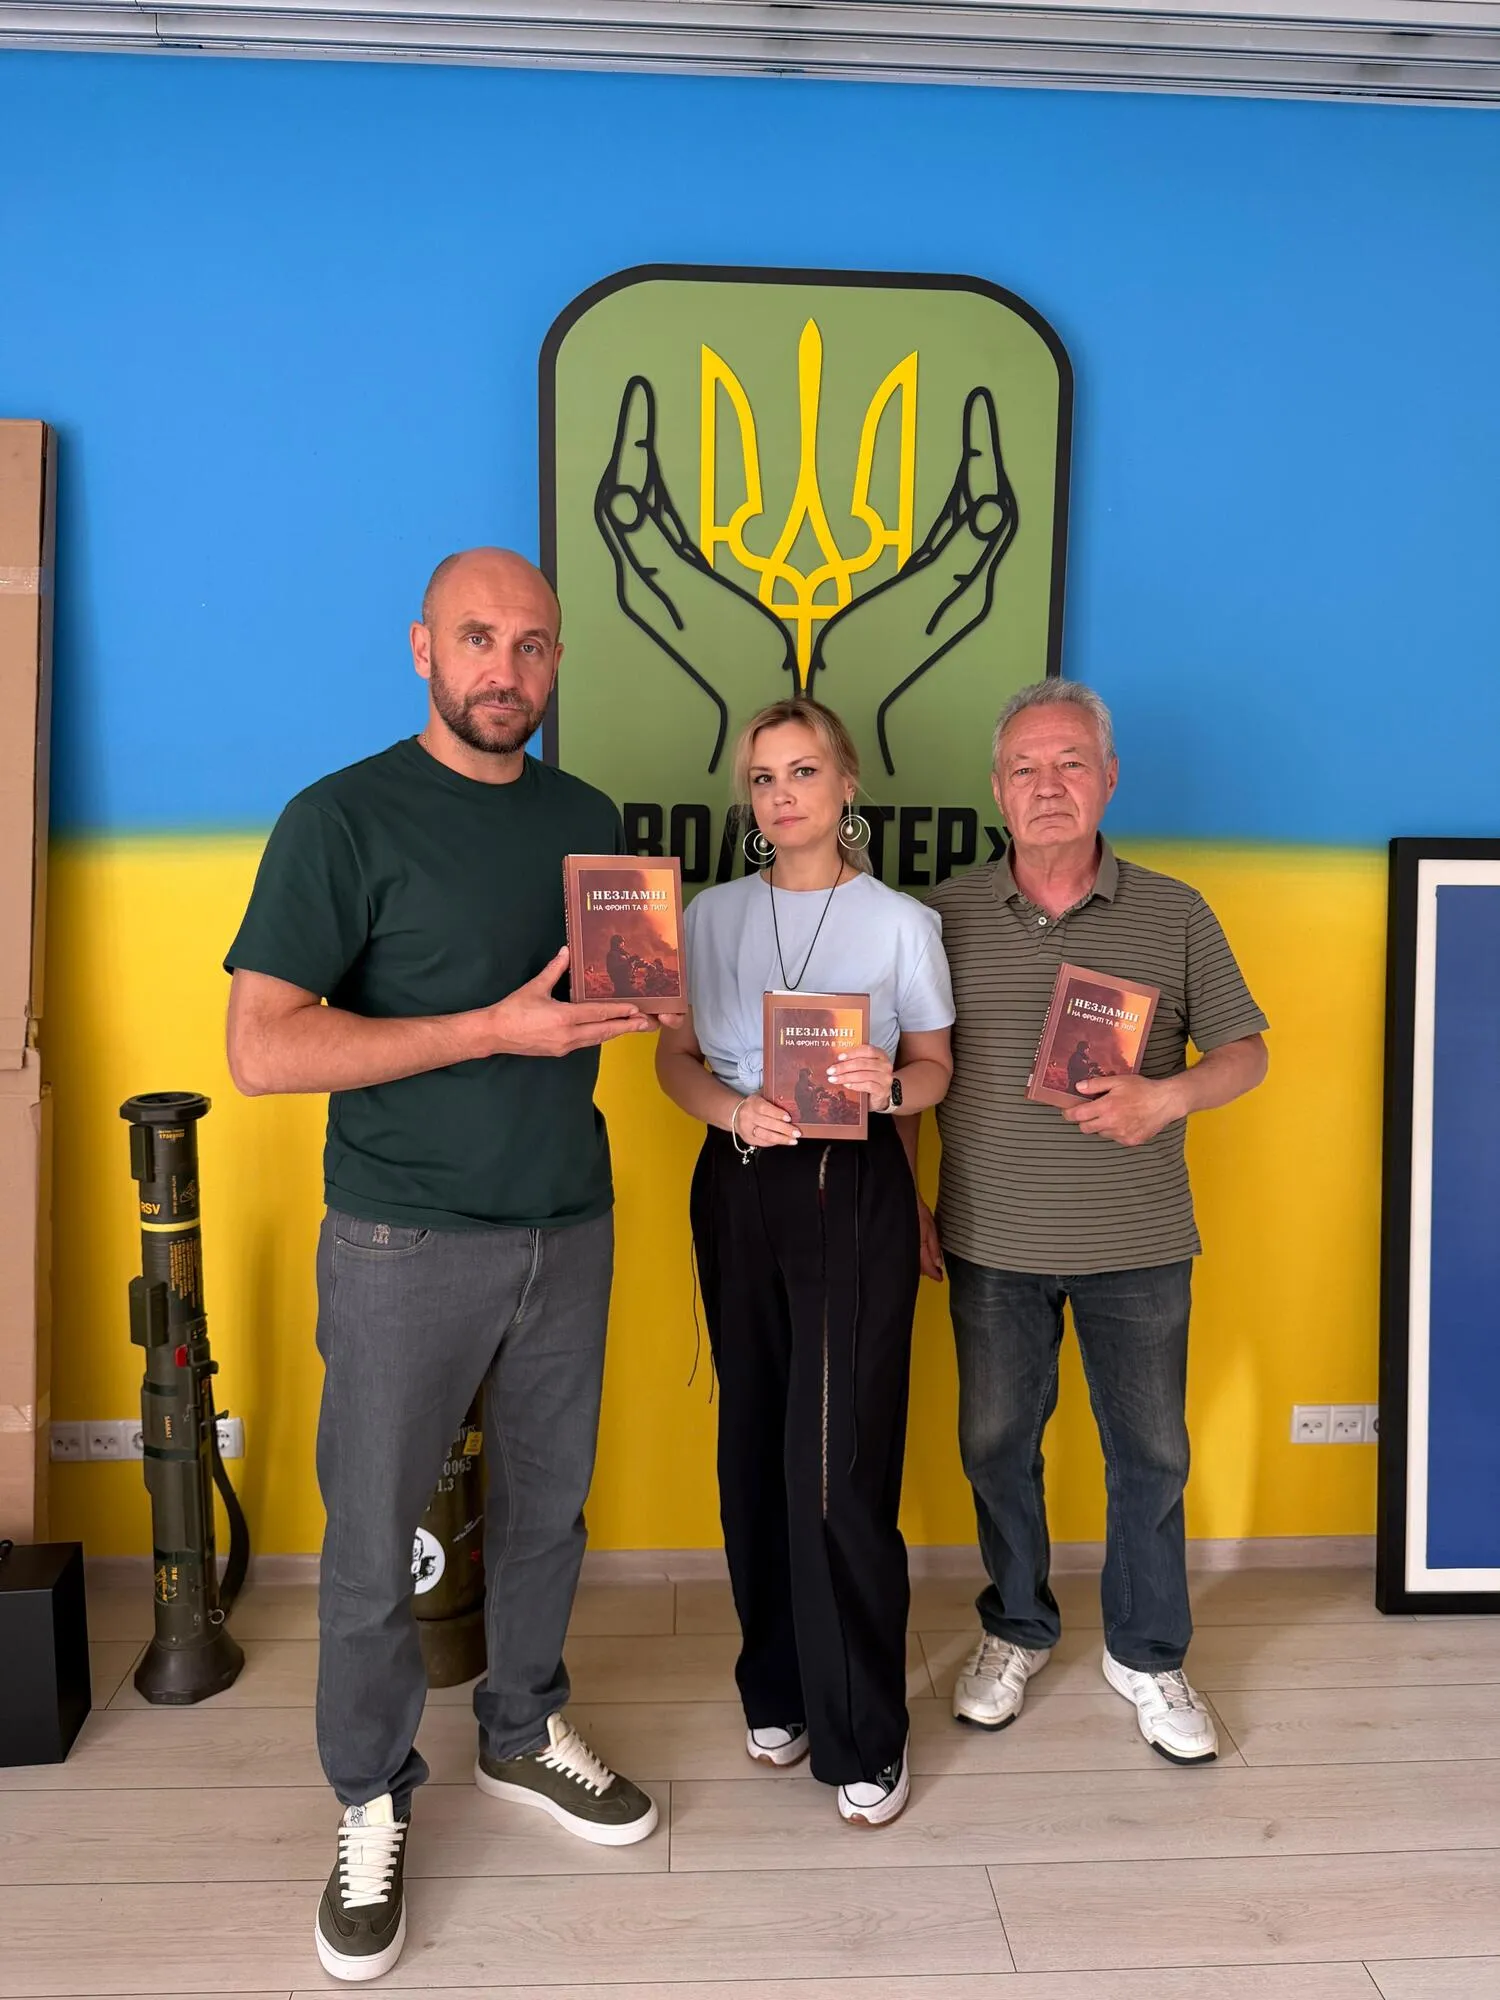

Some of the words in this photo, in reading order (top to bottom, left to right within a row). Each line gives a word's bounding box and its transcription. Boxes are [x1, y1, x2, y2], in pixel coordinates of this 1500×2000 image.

[592, 890, 668, 901] НЕЗЛАМНІ
[592, 904, 604, 912] НА
[604, 904, 631, 912] ФРОНТІ
[632, 904, 642, 912] ТА
[643, 904, 649, 912] В
[1074, 998, 1141, 1023] НЕЗЛАМНІ
[1071, 1009, 1081, 1018] НА
[1081, 1012, 1105, 1024] ФРОНТІ
[1105, 1017, 1114, 1027] ТА
[785, 1027, 855, 1038] НЕЗЛАМНІ
[820, 1040, 831, 1048] ТА
